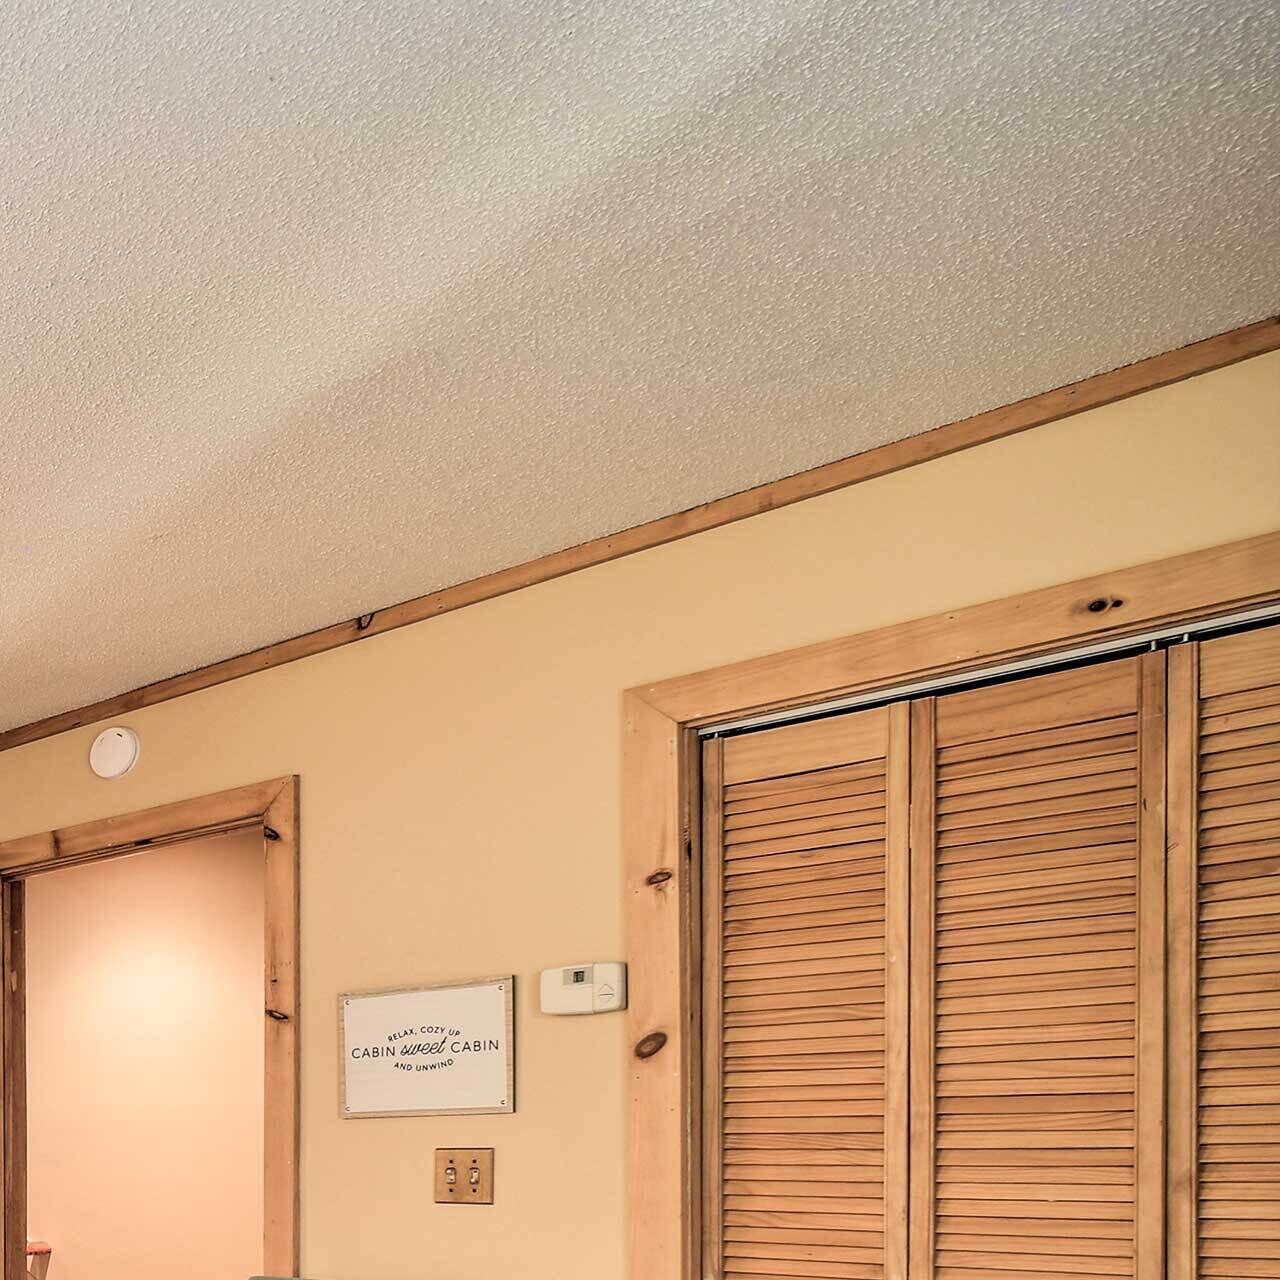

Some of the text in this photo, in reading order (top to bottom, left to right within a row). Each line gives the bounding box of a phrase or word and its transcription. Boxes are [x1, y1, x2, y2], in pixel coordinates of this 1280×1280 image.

[387, 1026, 461, 1042] RELAX, COZY UP
[351, 1036, 499, 1059] CABIN sweet CABIN
[393, 1058, 454, 1072] AND UNWIND
